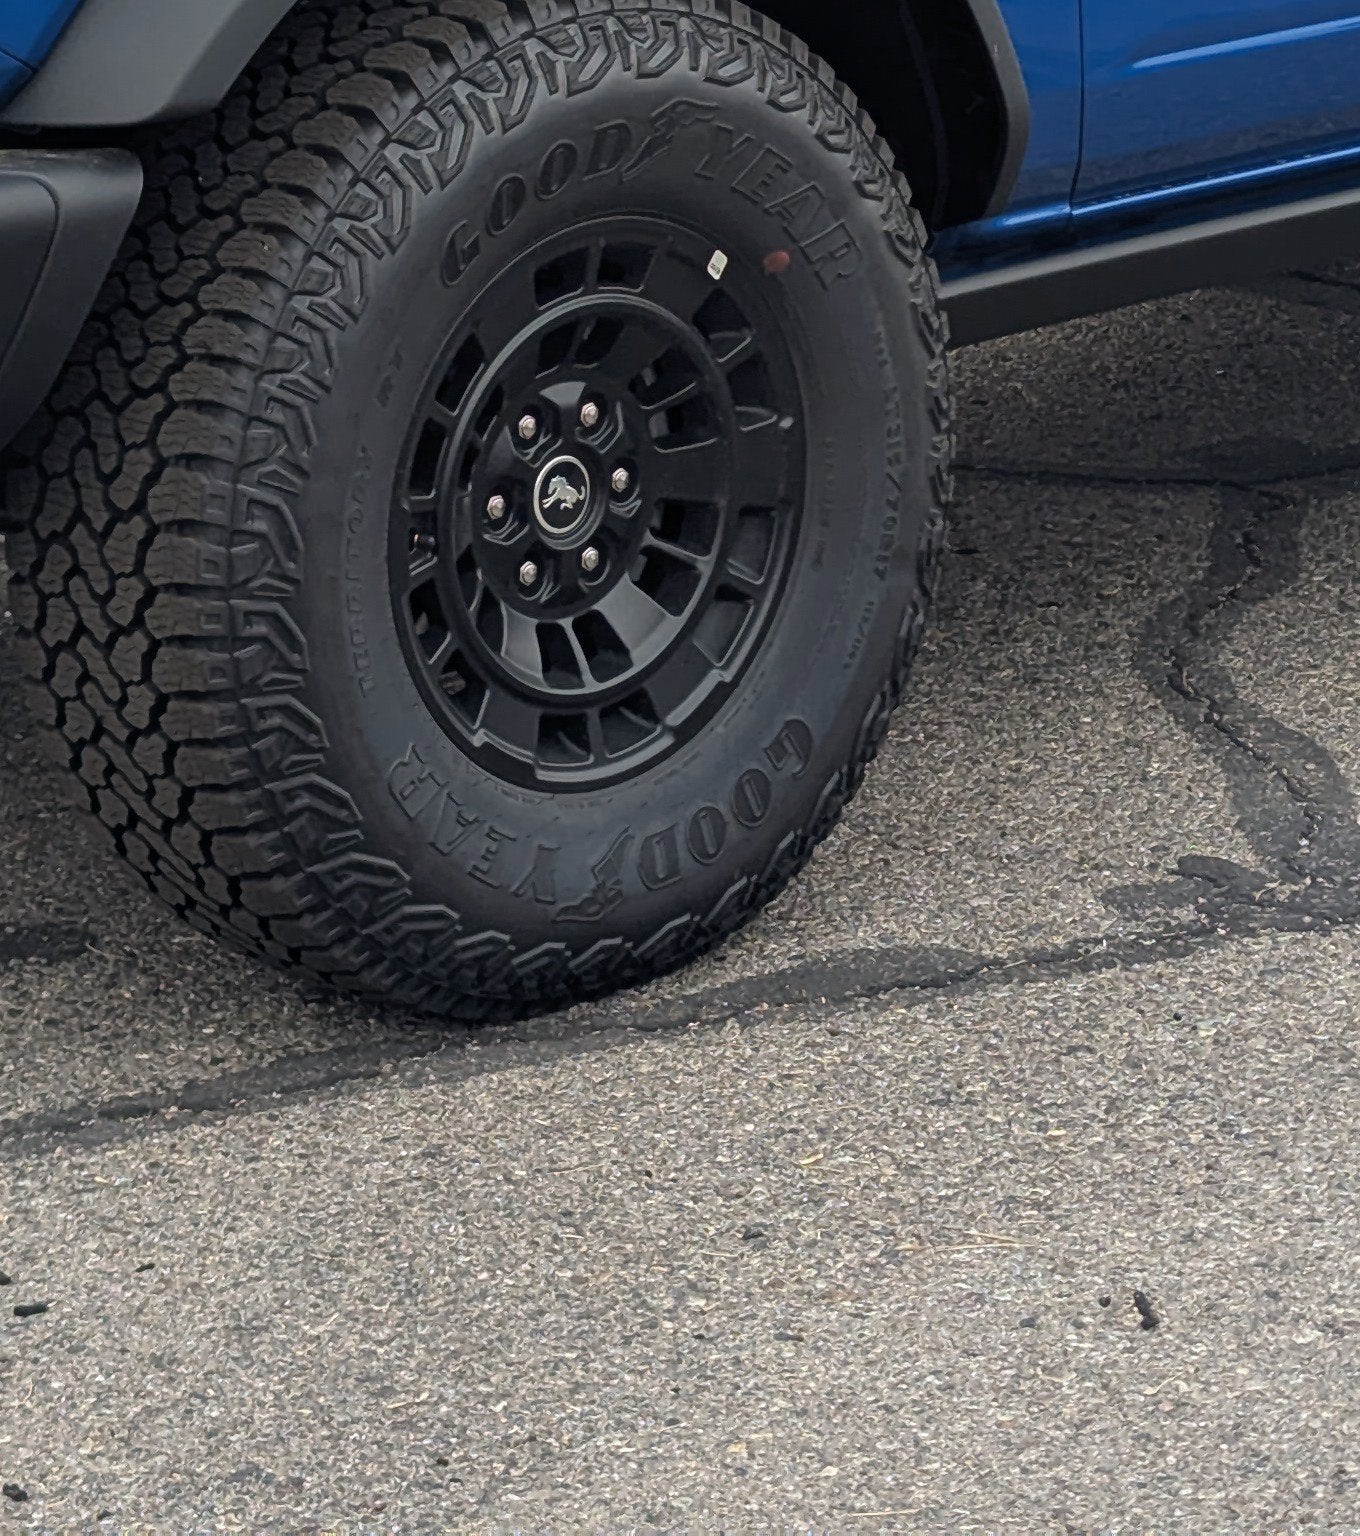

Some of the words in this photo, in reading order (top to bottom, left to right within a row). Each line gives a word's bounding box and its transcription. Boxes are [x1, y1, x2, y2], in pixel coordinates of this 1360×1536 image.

[440, 118, 635, 288] GOOD
[693, 120, 866, 292] YEAR
[387, 741, 563, 904] YEAR
[637, 717, 815, 892] GOOD
